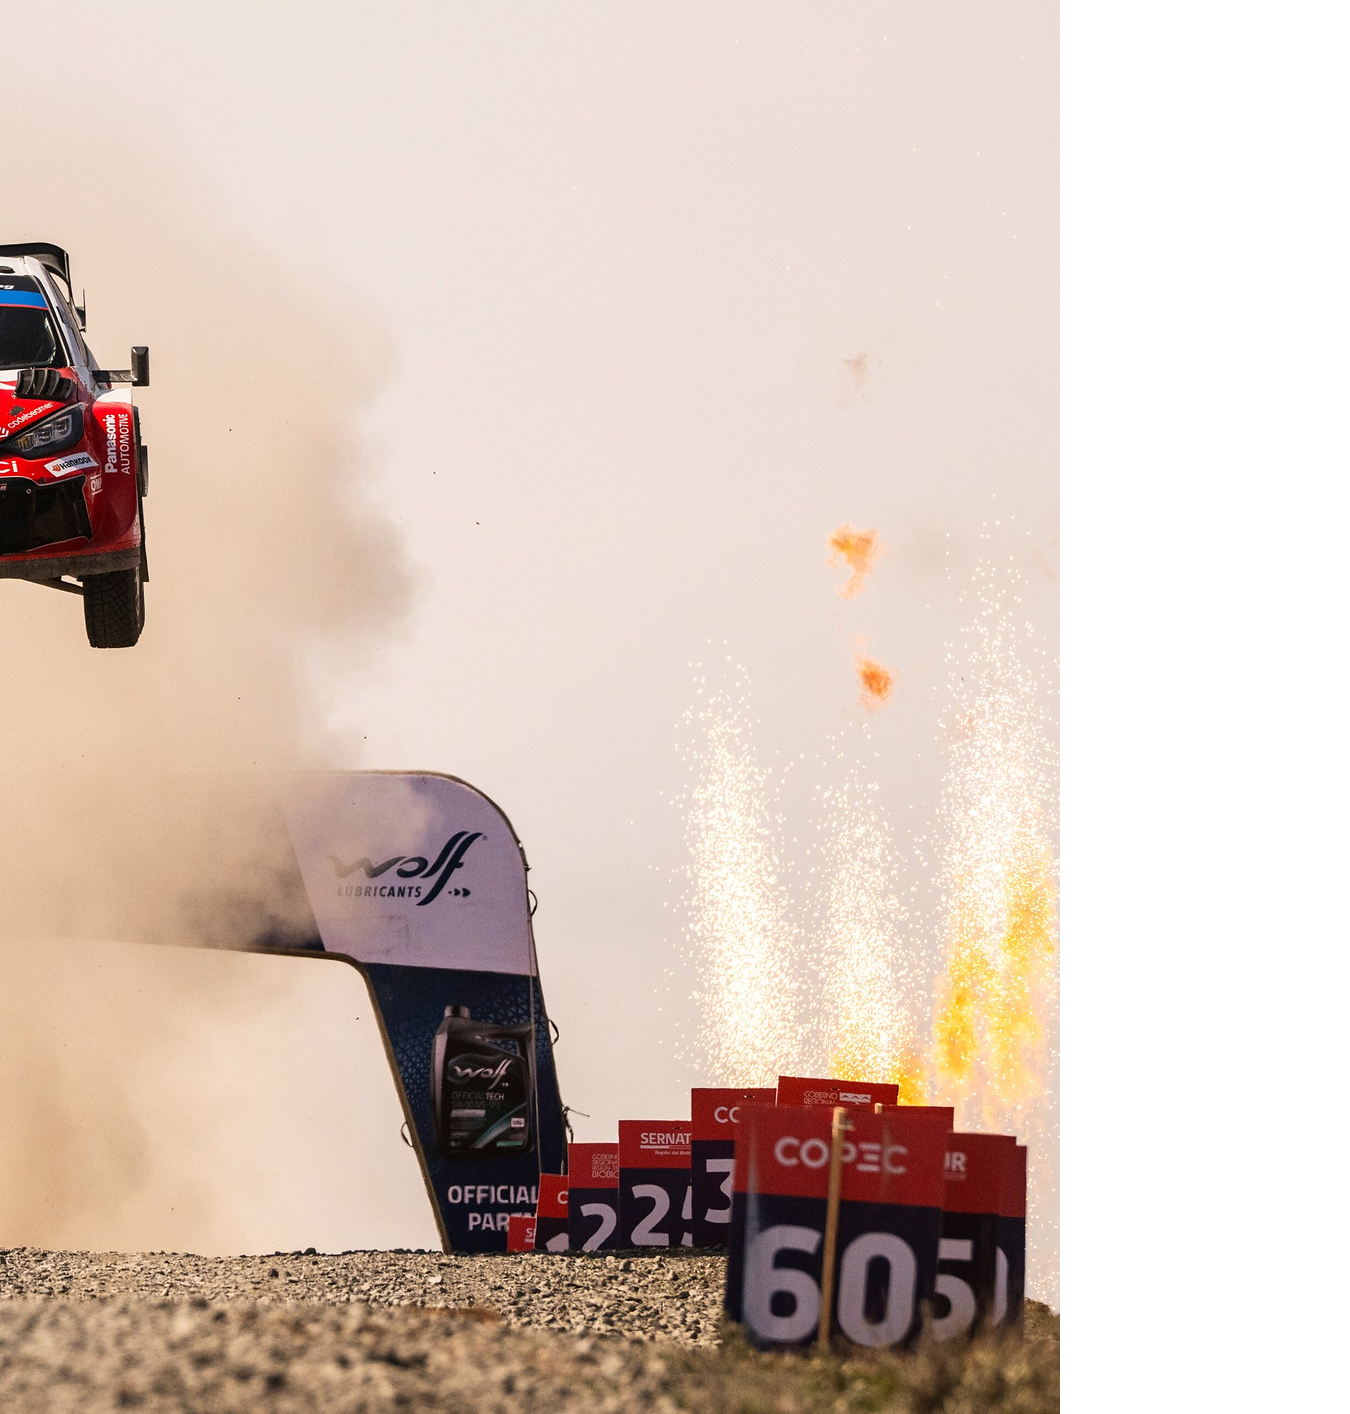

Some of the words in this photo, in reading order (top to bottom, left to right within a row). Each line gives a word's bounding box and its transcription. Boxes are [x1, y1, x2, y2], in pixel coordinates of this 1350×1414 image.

[102, 414, 118, 474] Panasonic
[118, 413, 131, 475] AUTOMOTIVE
[338, 886, 421, 898] LUBRICANTS
[447, 1186, 537, 1204] OFFICIAL
[743, 1223, 919, 1347] 60
